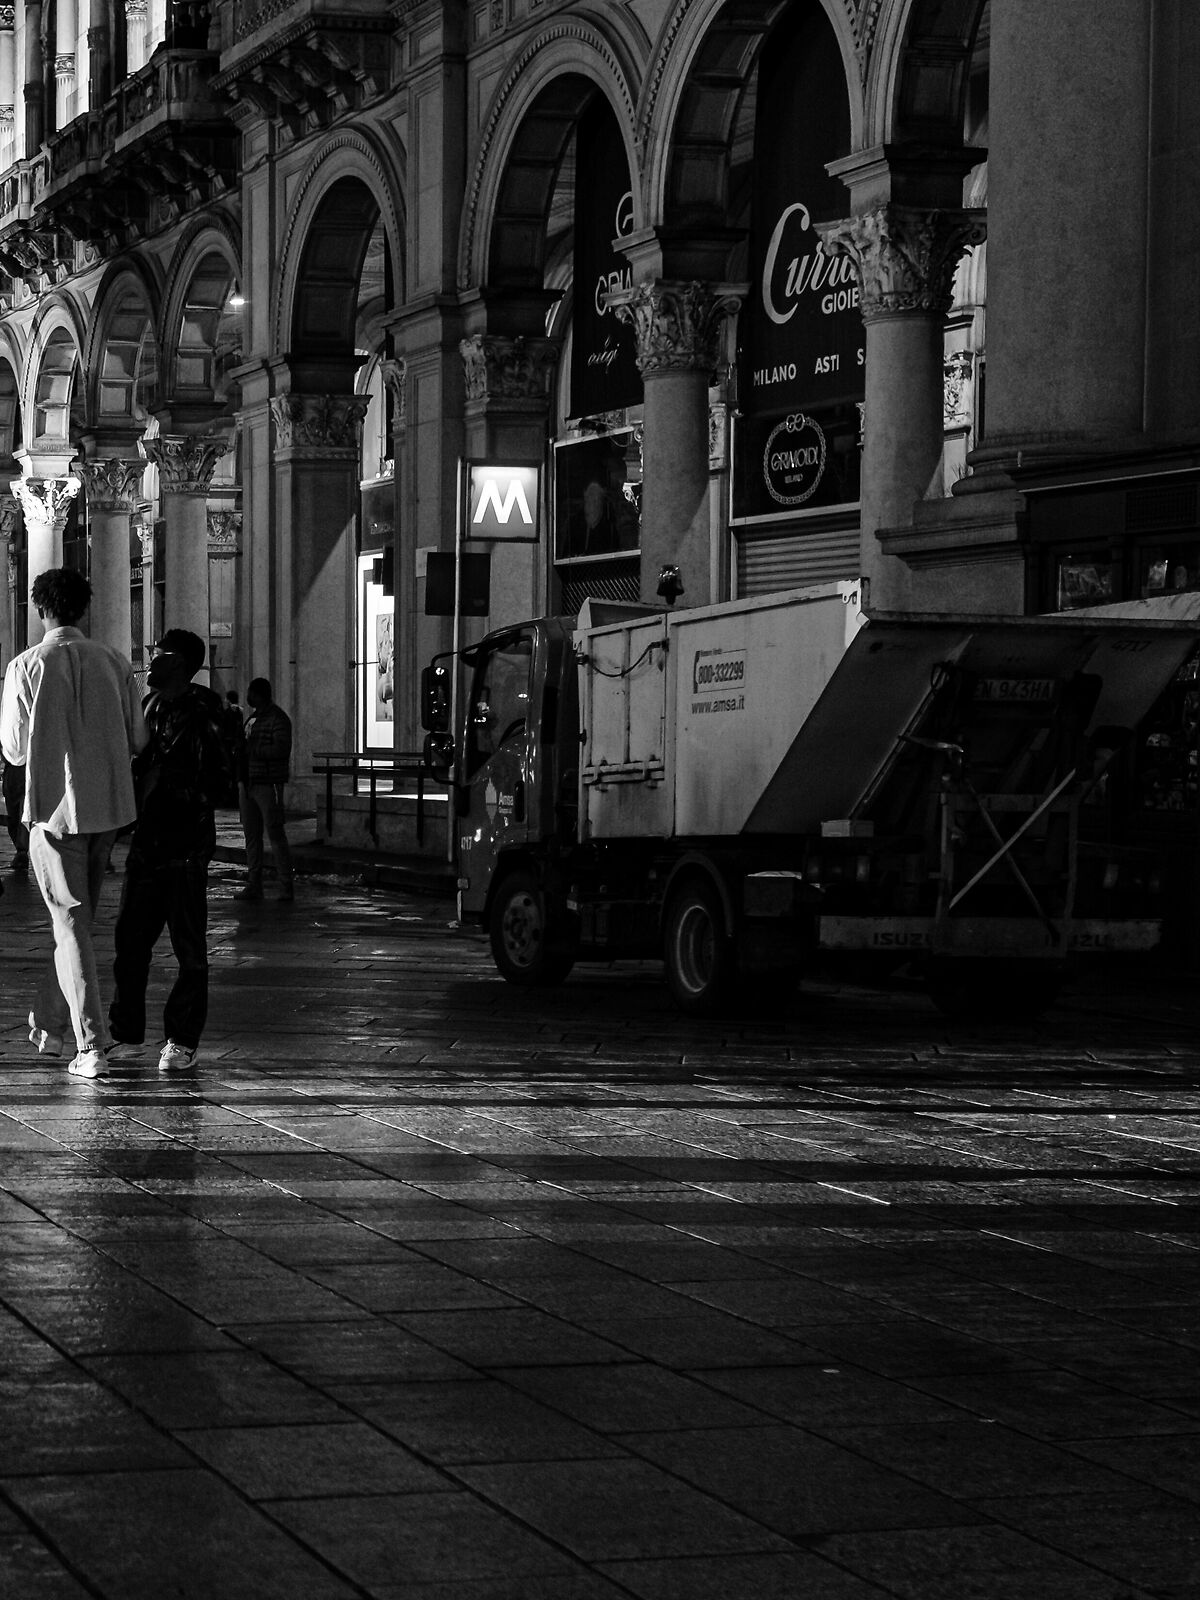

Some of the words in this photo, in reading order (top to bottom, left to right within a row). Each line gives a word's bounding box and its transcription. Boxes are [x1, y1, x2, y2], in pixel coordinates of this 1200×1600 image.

[753, 363, 797, 387] MILANO
[814, 354, 840, 375] ASTI
[856, 348, 867, 366] S
[771, 446, 819, 471] GRIMOLDI
[472, 479, 534, 524] M
[699, 661, 744, 684] 800-332299
[691, 695, 745, 714] www.amsa.it
